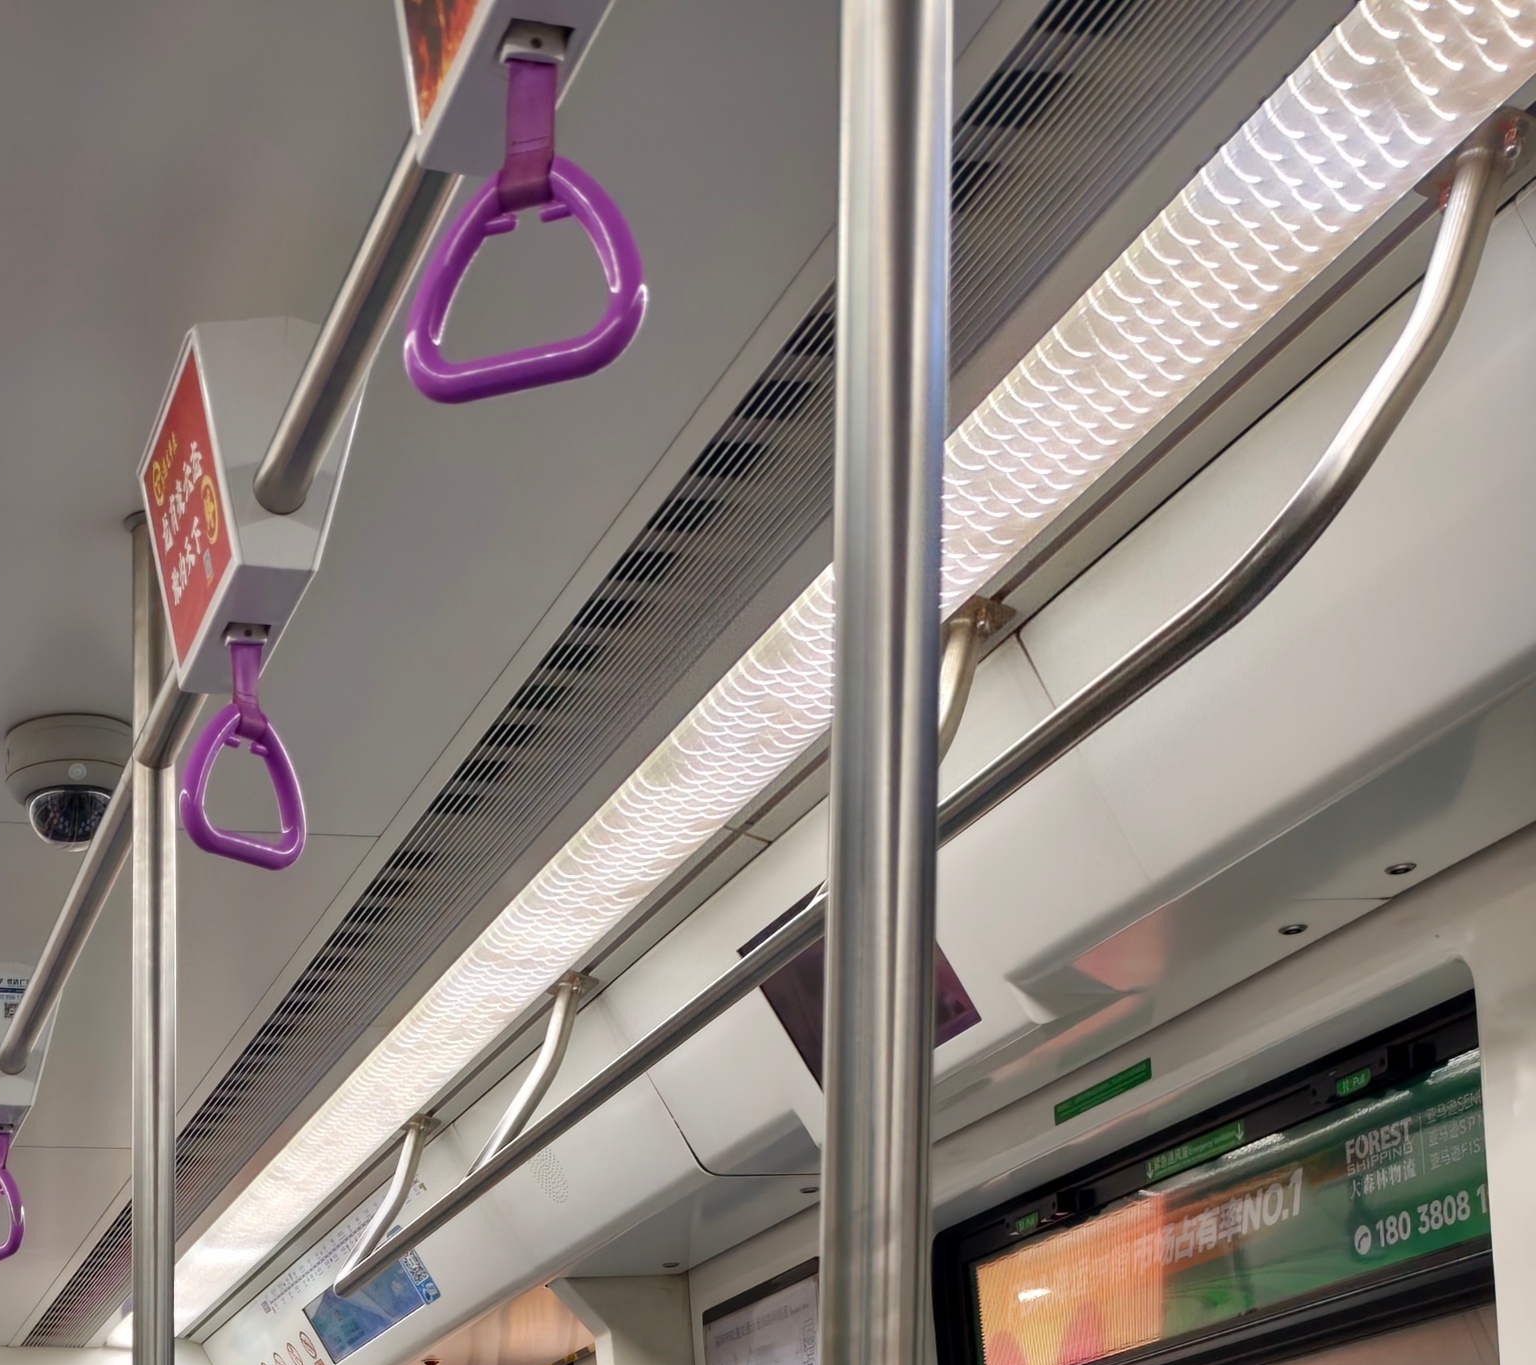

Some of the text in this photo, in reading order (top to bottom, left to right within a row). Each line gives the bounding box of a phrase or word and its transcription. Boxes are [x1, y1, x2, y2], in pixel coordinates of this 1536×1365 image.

[1345, 1116, 1412, 1164] FOREST
[1347, 1143, 1413, 1177] SHIPPING
[1350, 1158, 1417, 1200] 大森林物流
[1132, 1167, 1303, 1275] 市场占有率NO.1
[1375, 1210, 1411, 1248] 180
[1417, 1190, 1471, 1235] 3808
